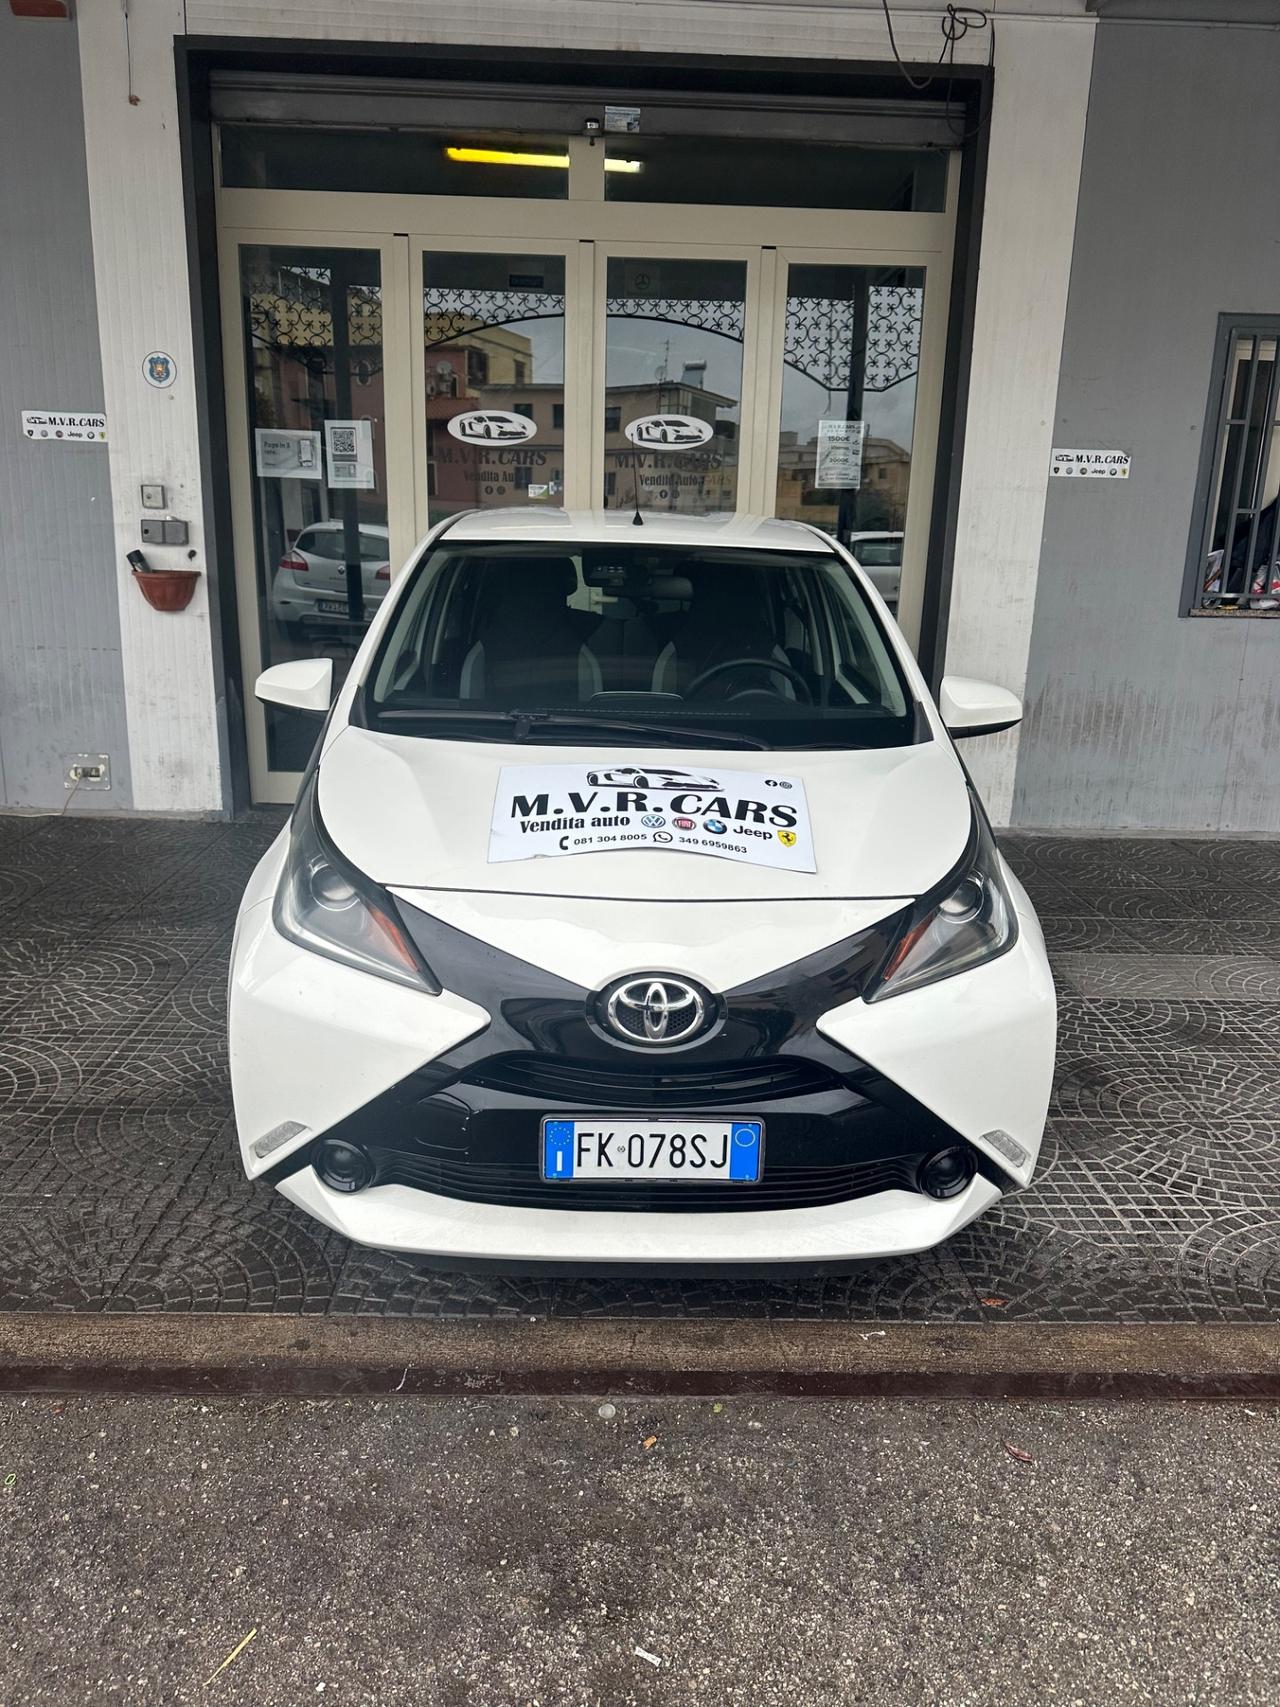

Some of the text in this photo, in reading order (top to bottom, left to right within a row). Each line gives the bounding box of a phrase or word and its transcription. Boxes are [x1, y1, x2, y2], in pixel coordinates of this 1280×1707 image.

[48, 416, 105, 428] M.V.R.CARS
[1076, 455, 1129, 464] M.V.R.CARS
[511, 791, 797, 828] M.V.R.CARS
[520, 817, 585, 834] Vendita
[591, 815, 630, 827] auto
[733, 825, 773, 840] Jeep
[573, 833, 748, 853] 081 304 8005 349 6959863
